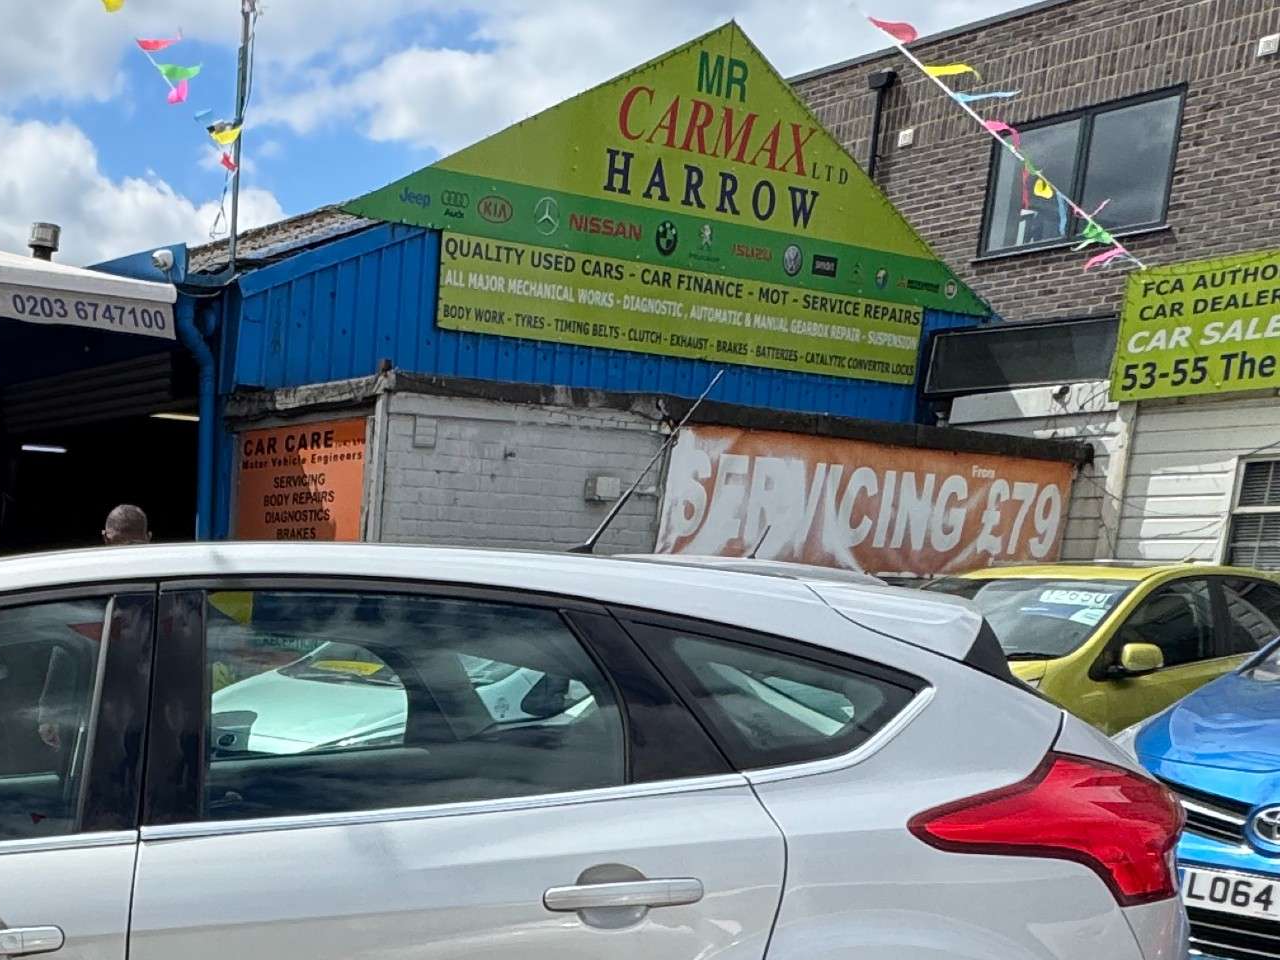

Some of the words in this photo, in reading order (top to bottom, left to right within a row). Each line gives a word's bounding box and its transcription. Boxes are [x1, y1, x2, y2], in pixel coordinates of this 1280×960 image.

[697, 50, 749, 103] MR
[618, 86, 818, 176] CARMAX
[811, 162, 849, 185] LTD
[399, 187, 432, 209] Jeep
[603, 147, 820, 229] HARROW
[483, 200, 508, 219] KIA
[569, 213, 643, 241] NISSAN
[445, 238, 525, 266] QUALITY
[530, 251, 576, 273] USED
[581, 259, 624, 281] CARS
[640, 268, 672, 288] CAR
[677, 274, 744, 299] FINANCE
[758, 287, 789, 305] MOT
[803, 294, 860, 317] SERVICE
[863, 303, 920, 326] REPAIRS
[1142, 278, 1185, 298] FCA
[1192, 263, 1280, 292] AUTHO
[12, 294, 68, 319] 0203
[74, 301, 166, 331] 6747100
[444, 270, 465, 288] ALL
[468, 272, 506, 293] MAJOR
[507, 278, 574, 302] MECHANICAL
[577, 288, 615, 308] WORKS
[622, 294, 683, 318] DIAGNOSTIC
[689, 304, 743, 327] AUTOMATIC
[744, 315, 752, 328] &
[753, 315, 789, 334] MANUAL
[790, 319, 829, 338] GEARBOX
[829, 325, 861, 342] REPAIR
[867, 330, 918, 350] SUSPENSION
[1139, 301, 1185, 322] CAR
[443, 304, 472, 321] BODY
[474, 307, 506, 325] WORK
[514, 313, 545, 329] TYRES
[554, 318, 590, 336] TIMING
[591, 323, 620, 340] BELTS
[628, 327, 662, 345] CLUTCH
[670, 334, 709, 350] EXHAUST
[716, 340, 749, 356] BRAKES
[755, 345, 799, 362] BATTERIES
[805, 350, 847, 369] CATALYTIC
[847, 356, 891, 374] CONVERTER
[891, 362, 914, 376] LOCKS
[1126, 326, 1193, 354] CAR
[1121, 355, 1209, 392] 53-55
[1220, 350, 1277, 381] The
[243, 436, 277, 457] CAR
[284, 430, 335, 453] CARE
[241, 458, 268, 470] Motor
[271, 454, 307, 468] Vehicle
[310, 450, 363, 465] Engineers
[972, 465, 996, 479] From
[273, 472, 326, 489] SERVICING
[263, 493, 290, 508] BODY
[291, 490, 336, 506] REPAIRS
[668, 432, 969, 552] SERVICING
[976, 479, 1062, 559] £79
[264, 508, 330, 525] DIAGNOSTICS
[276, 527, 317, 541] BRAKES
[1185, 871, 1274, 912] LO64
